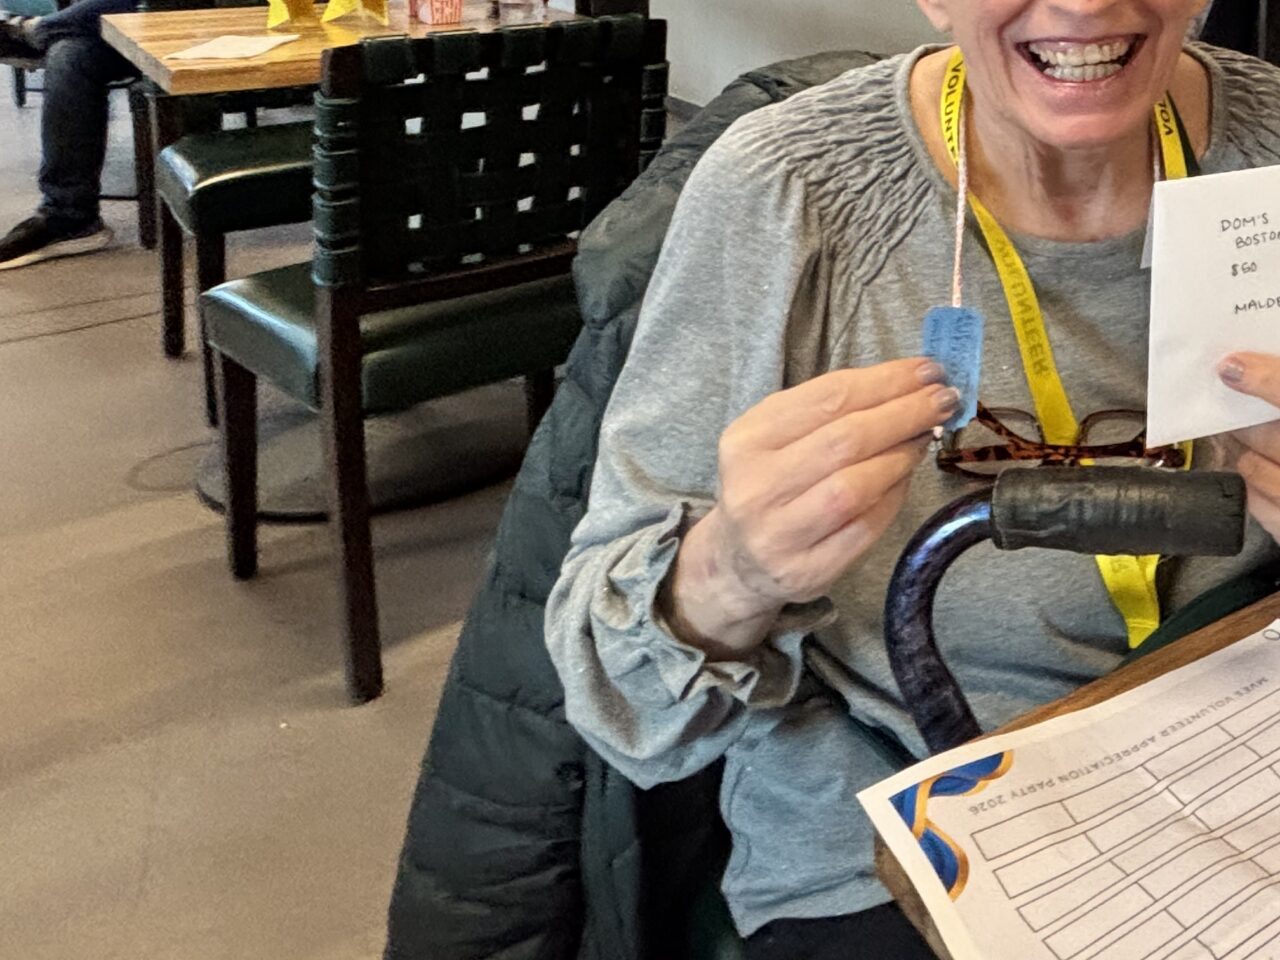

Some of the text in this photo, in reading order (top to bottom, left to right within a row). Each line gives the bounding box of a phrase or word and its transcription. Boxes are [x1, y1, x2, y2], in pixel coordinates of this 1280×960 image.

[1221, 212, 1269, 232] DOM'S
[1160, 696, 1235, 738] VOLUNTEER
[1057, 736, 1156, 783] APPRECIATION
[1010, 778, 1056, 800] PARTY
[967, 795, 1007, 816] 2026
